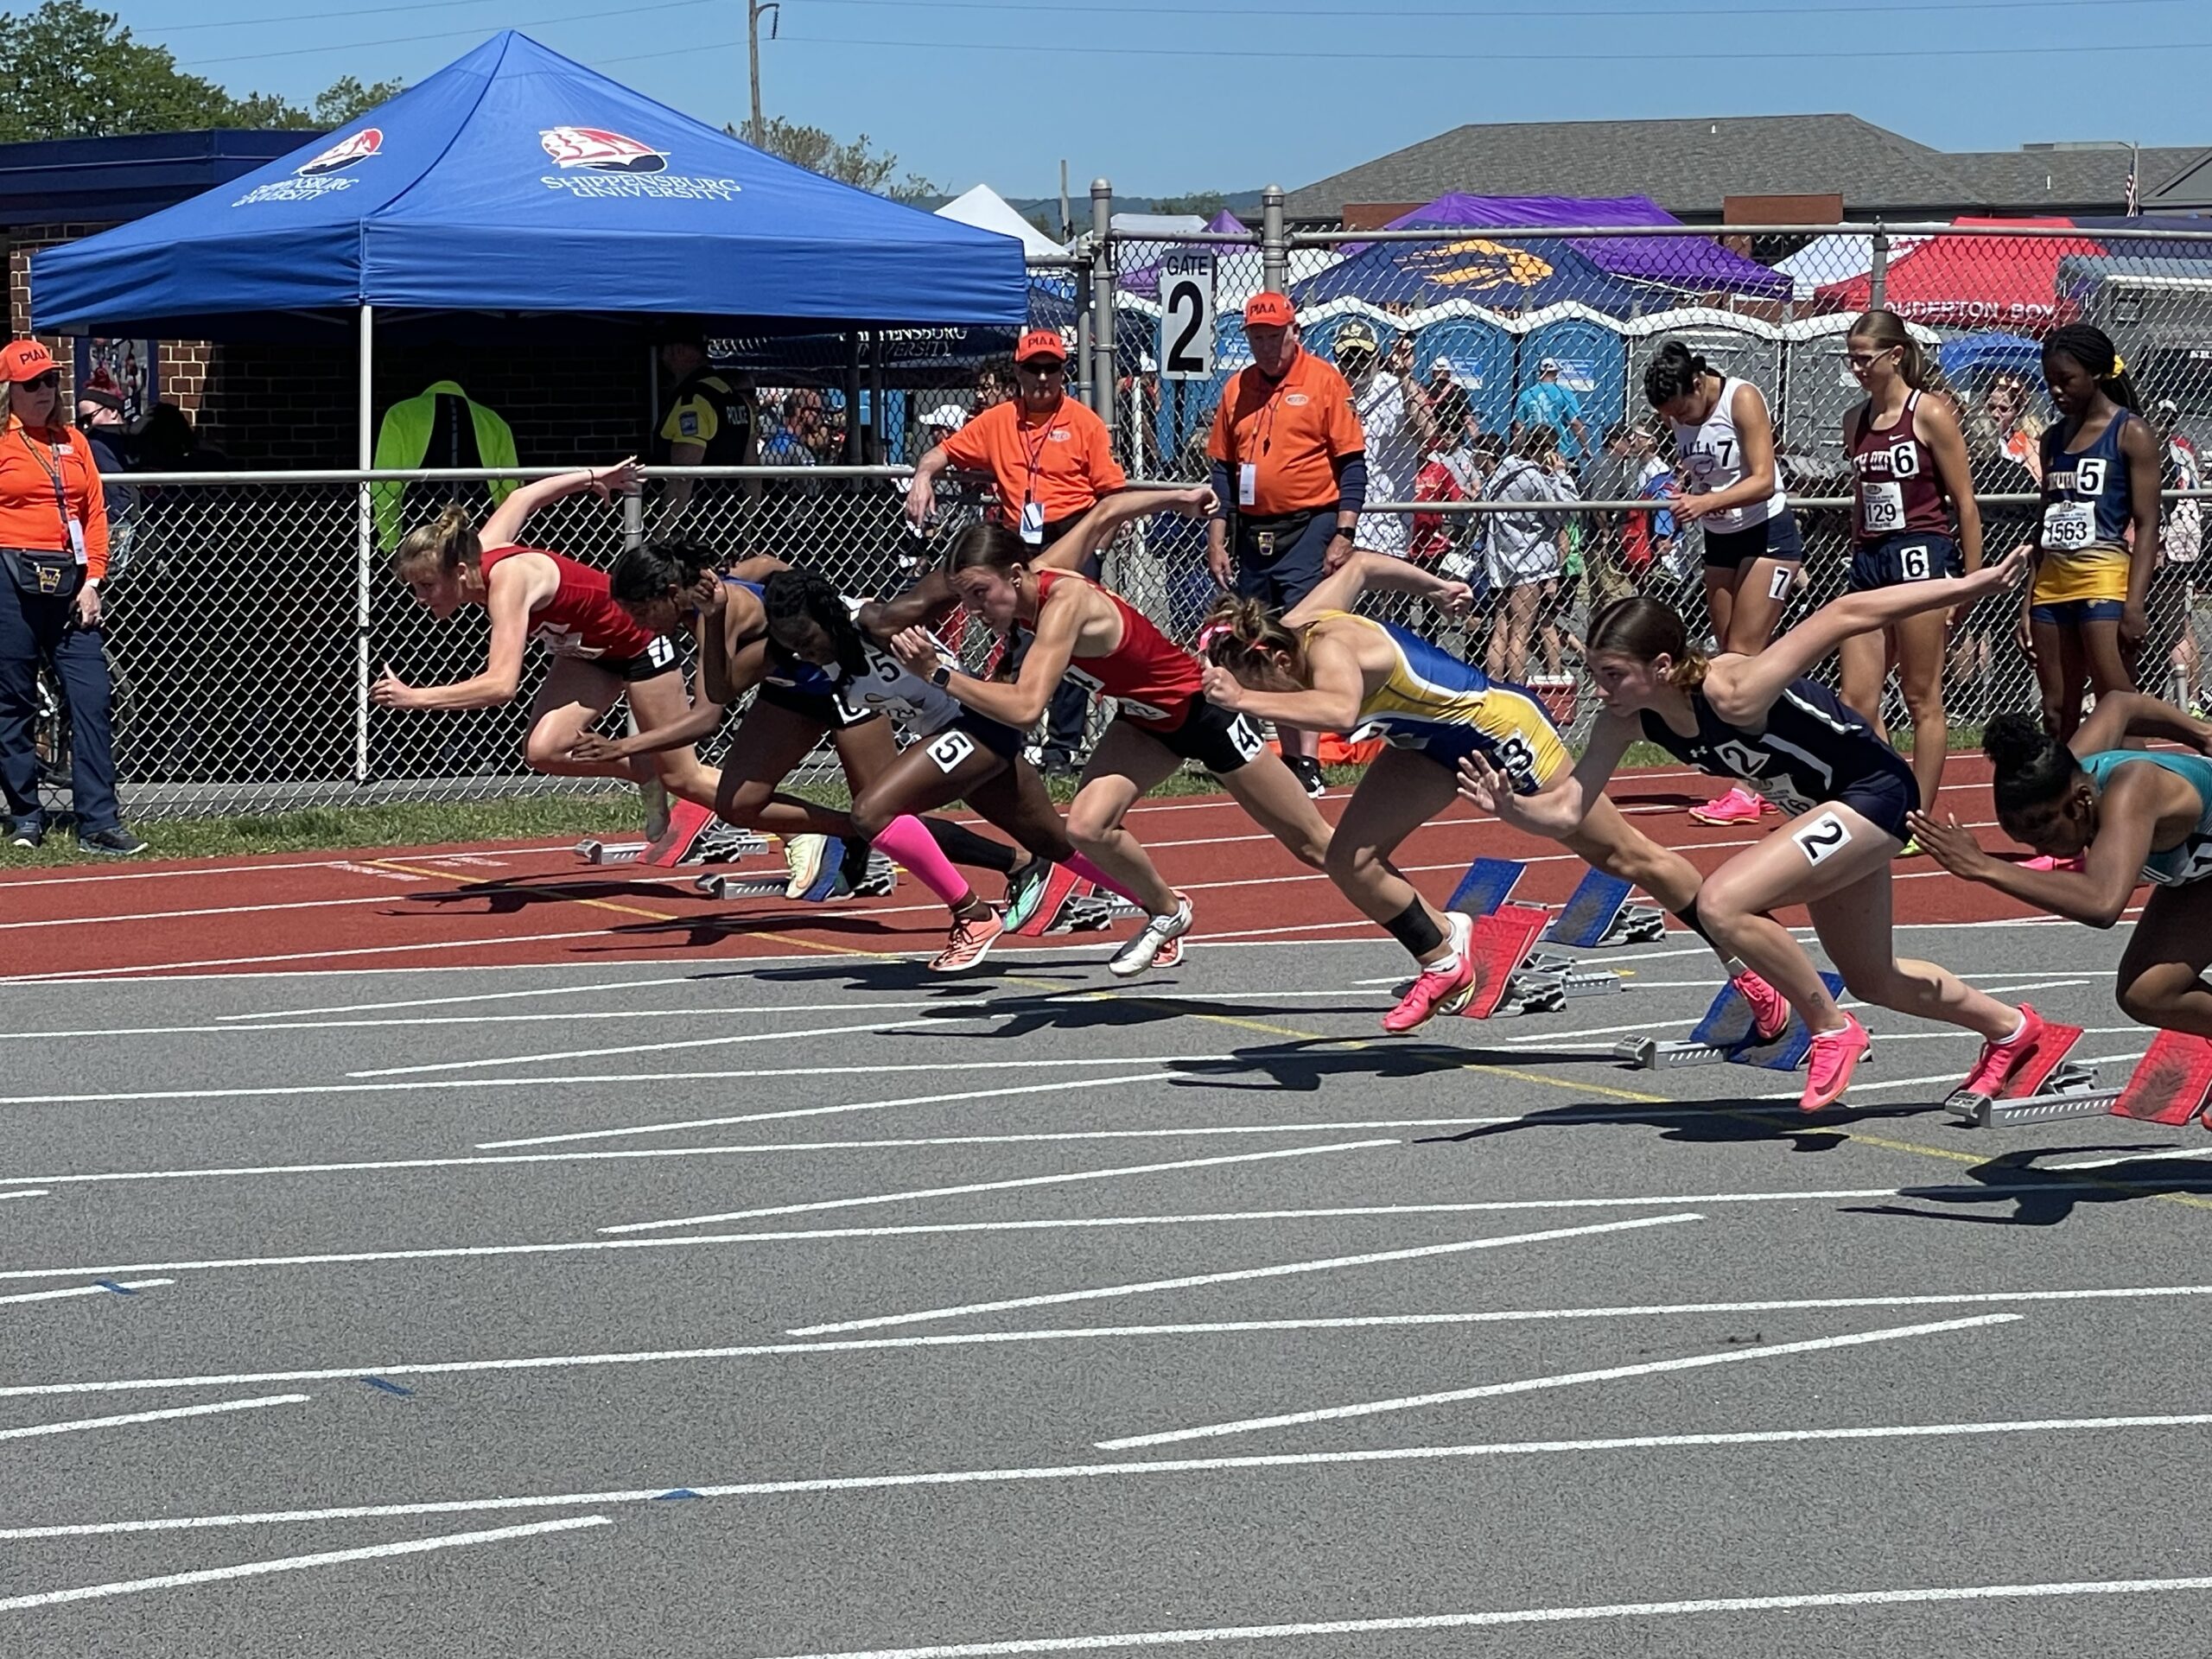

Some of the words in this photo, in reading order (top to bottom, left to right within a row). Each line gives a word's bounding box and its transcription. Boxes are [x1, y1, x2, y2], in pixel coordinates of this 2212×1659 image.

[540, 175, 741, 192] SHIPPENSBURG
[572, 185, 734, 201] UNIVERSITY
[1166, 255, 1208, 276] GATE
[1249, 302, 1276, 316] PIAA
[1883, 301, 1999, 318] OUDERTON
[1166, 280, 1204, 372] 2
[1028, 336, 1055, 348] PIAA
[726, 405, 748, 424] POLICE
[1717, 441, 1732, 467] 7
[1894, 445, 1914, 474] 6
[2080, 461, 2100, 492] 5
[1867, 503, 1897, 522] 129
[2048, 521, 2088, 543] 1563
[1905, 550, 1924, 577] 6
[1777, 569, 1789, 596] 7
[870, 654, 900, 683] 5
[1237, 721, 1258, 751] 4
[935, 734, 968, 764] 5
[1722, 747, 1765, 772] 2
[1801, 819, 1843, 860] 2
